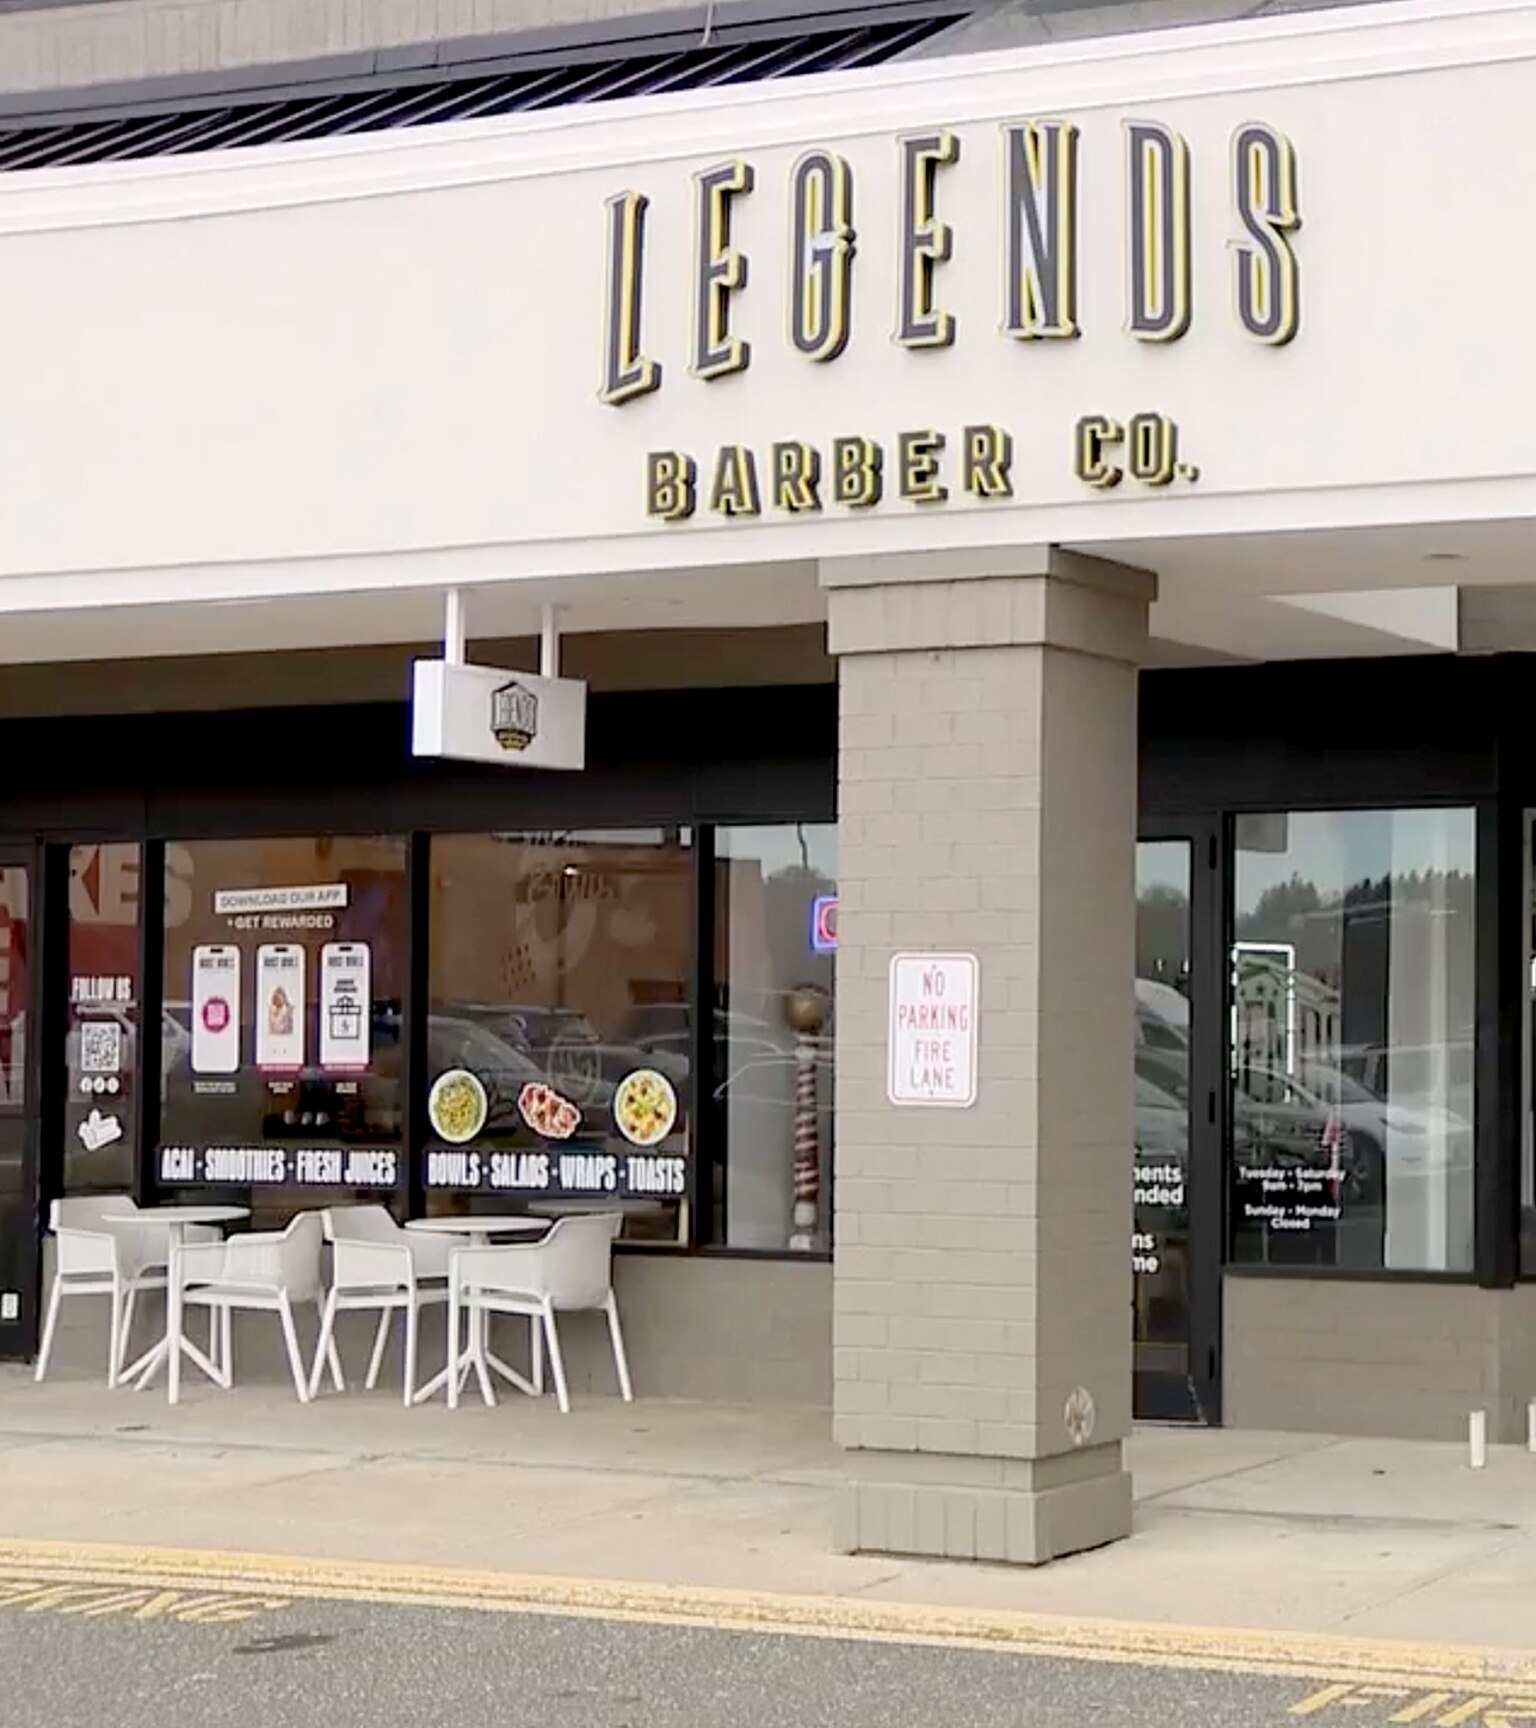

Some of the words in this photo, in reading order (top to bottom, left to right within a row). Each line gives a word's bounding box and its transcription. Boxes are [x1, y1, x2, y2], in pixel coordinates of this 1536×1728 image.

[597, 118, 1302, 407] LEGENDS
[646, 424, 1014, 520] BARBER
[1075, 412, 1199, 487] CO.
[234, 914, 260, 928] GET
[262, 914, 334, 928] REWARDED
[72, 976, 115, 1000] FOLLOW
[116, 976, 132, 1000] US
[922, 970, 945, 997] NO
[898, 1004, 968, 1031] PARKING
[914, 1039, 952, 1063] FIRE
[909, 1066, 956, 1090] LANE
[161, 1148, 195, 1181] ACAI
[205, 1148, 285, 1182] SMOOTHIES
[296, 1149, 342, 1183] FRESH
[344, 1150, 396, 1185] JUICES
[427, 1152, 480, 1186] BOWLS
[491, 1153, 549, 1188] SALADS
[559, 1154, 617, 1190] WRAPS
[627, 1156, 685, 1192] TOASTS
[1239, 1166, 1285, 1181] Tuesday
[1295, 1166, 1346, 1182] Saturday
[1244, 1203, 1286, 1218] Sunday
[1295, 1204, 1340, 1219] Monday
[1270, 1217, 1311, 1230] Closed
